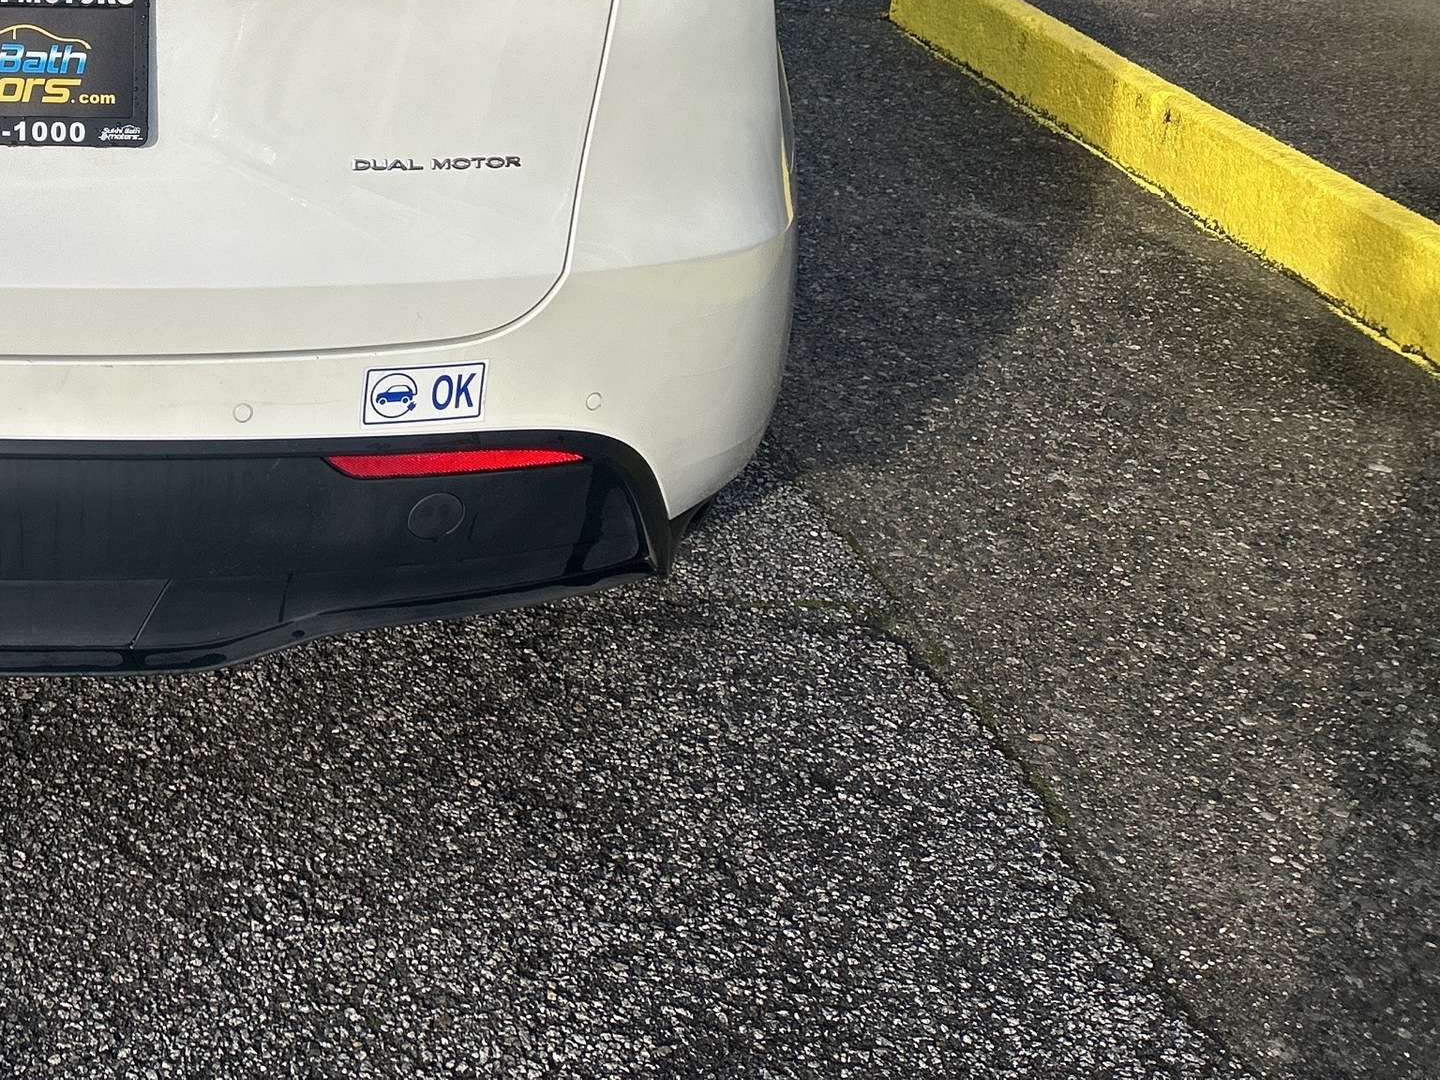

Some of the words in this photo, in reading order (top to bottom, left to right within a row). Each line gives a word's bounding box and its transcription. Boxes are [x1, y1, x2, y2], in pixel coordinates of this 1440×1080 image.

[352, 158, 423, 171] DUAL
[431, 156, 521, 170] MOTOR
[431, 372, 477, 410] OK
